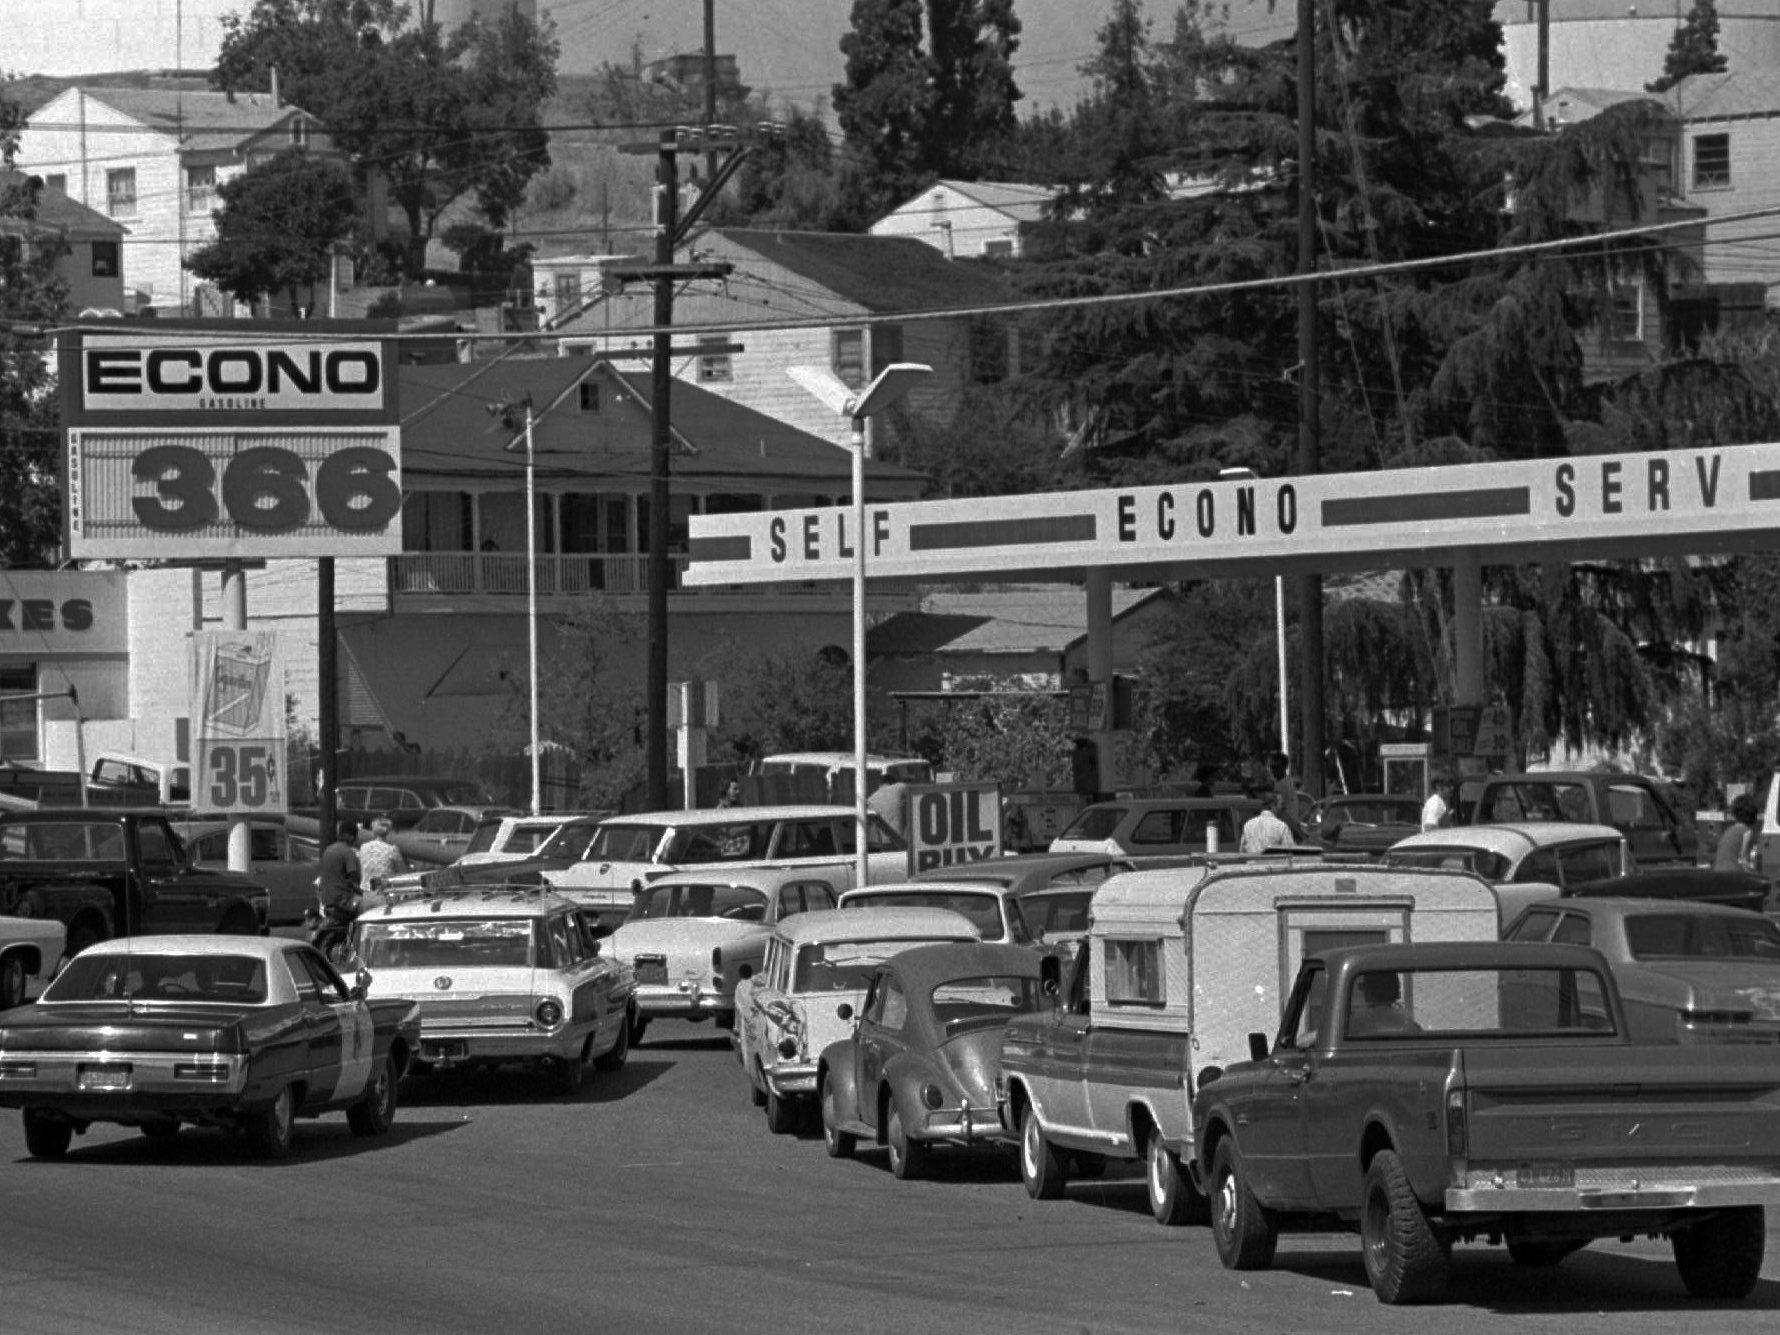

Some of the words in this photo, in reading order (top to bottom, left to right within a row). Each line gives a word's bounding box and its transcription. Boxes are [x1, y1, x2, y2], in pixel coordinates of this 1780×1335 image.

[87, 351, 380, 393] ECONO
[199, 398, 266, 409] GASOLINE
[132, 445, 401, 533] 366
[770, 510, 890, 562] SELF
[1118, 484, 1298, 541] ECONO
[1555, 455, 1721, 517] SERV
[920, 791, 994, 845] OIL
